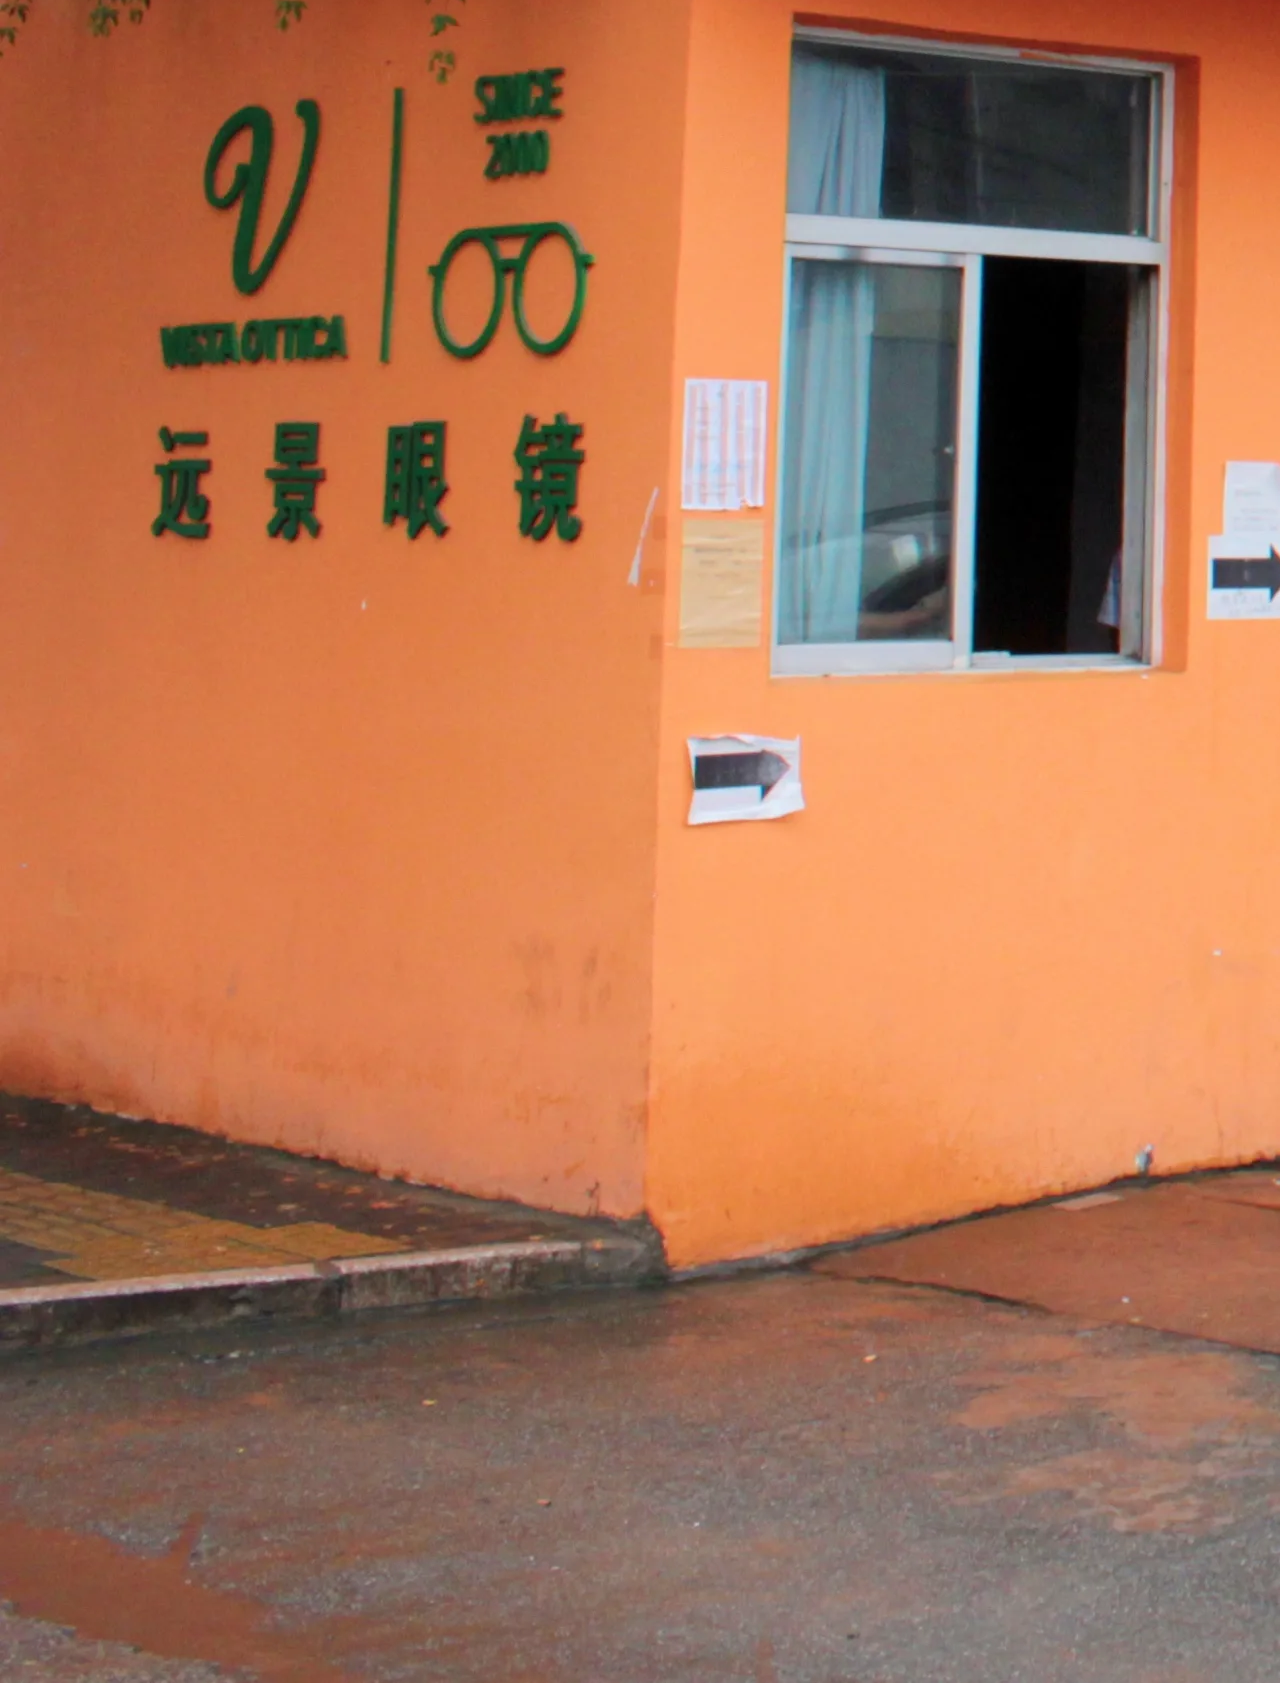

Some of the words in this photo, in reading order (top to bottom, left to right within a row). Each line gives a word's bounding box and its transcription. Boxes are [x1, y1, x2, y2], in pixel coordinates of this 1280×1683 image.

[473, 67, 565, 124] SINCE
[160, 322, 240, 369] VISTA
[240, 314, 348, 364] OTTICA
[151, 413, 586, 542] 远景眼镜
